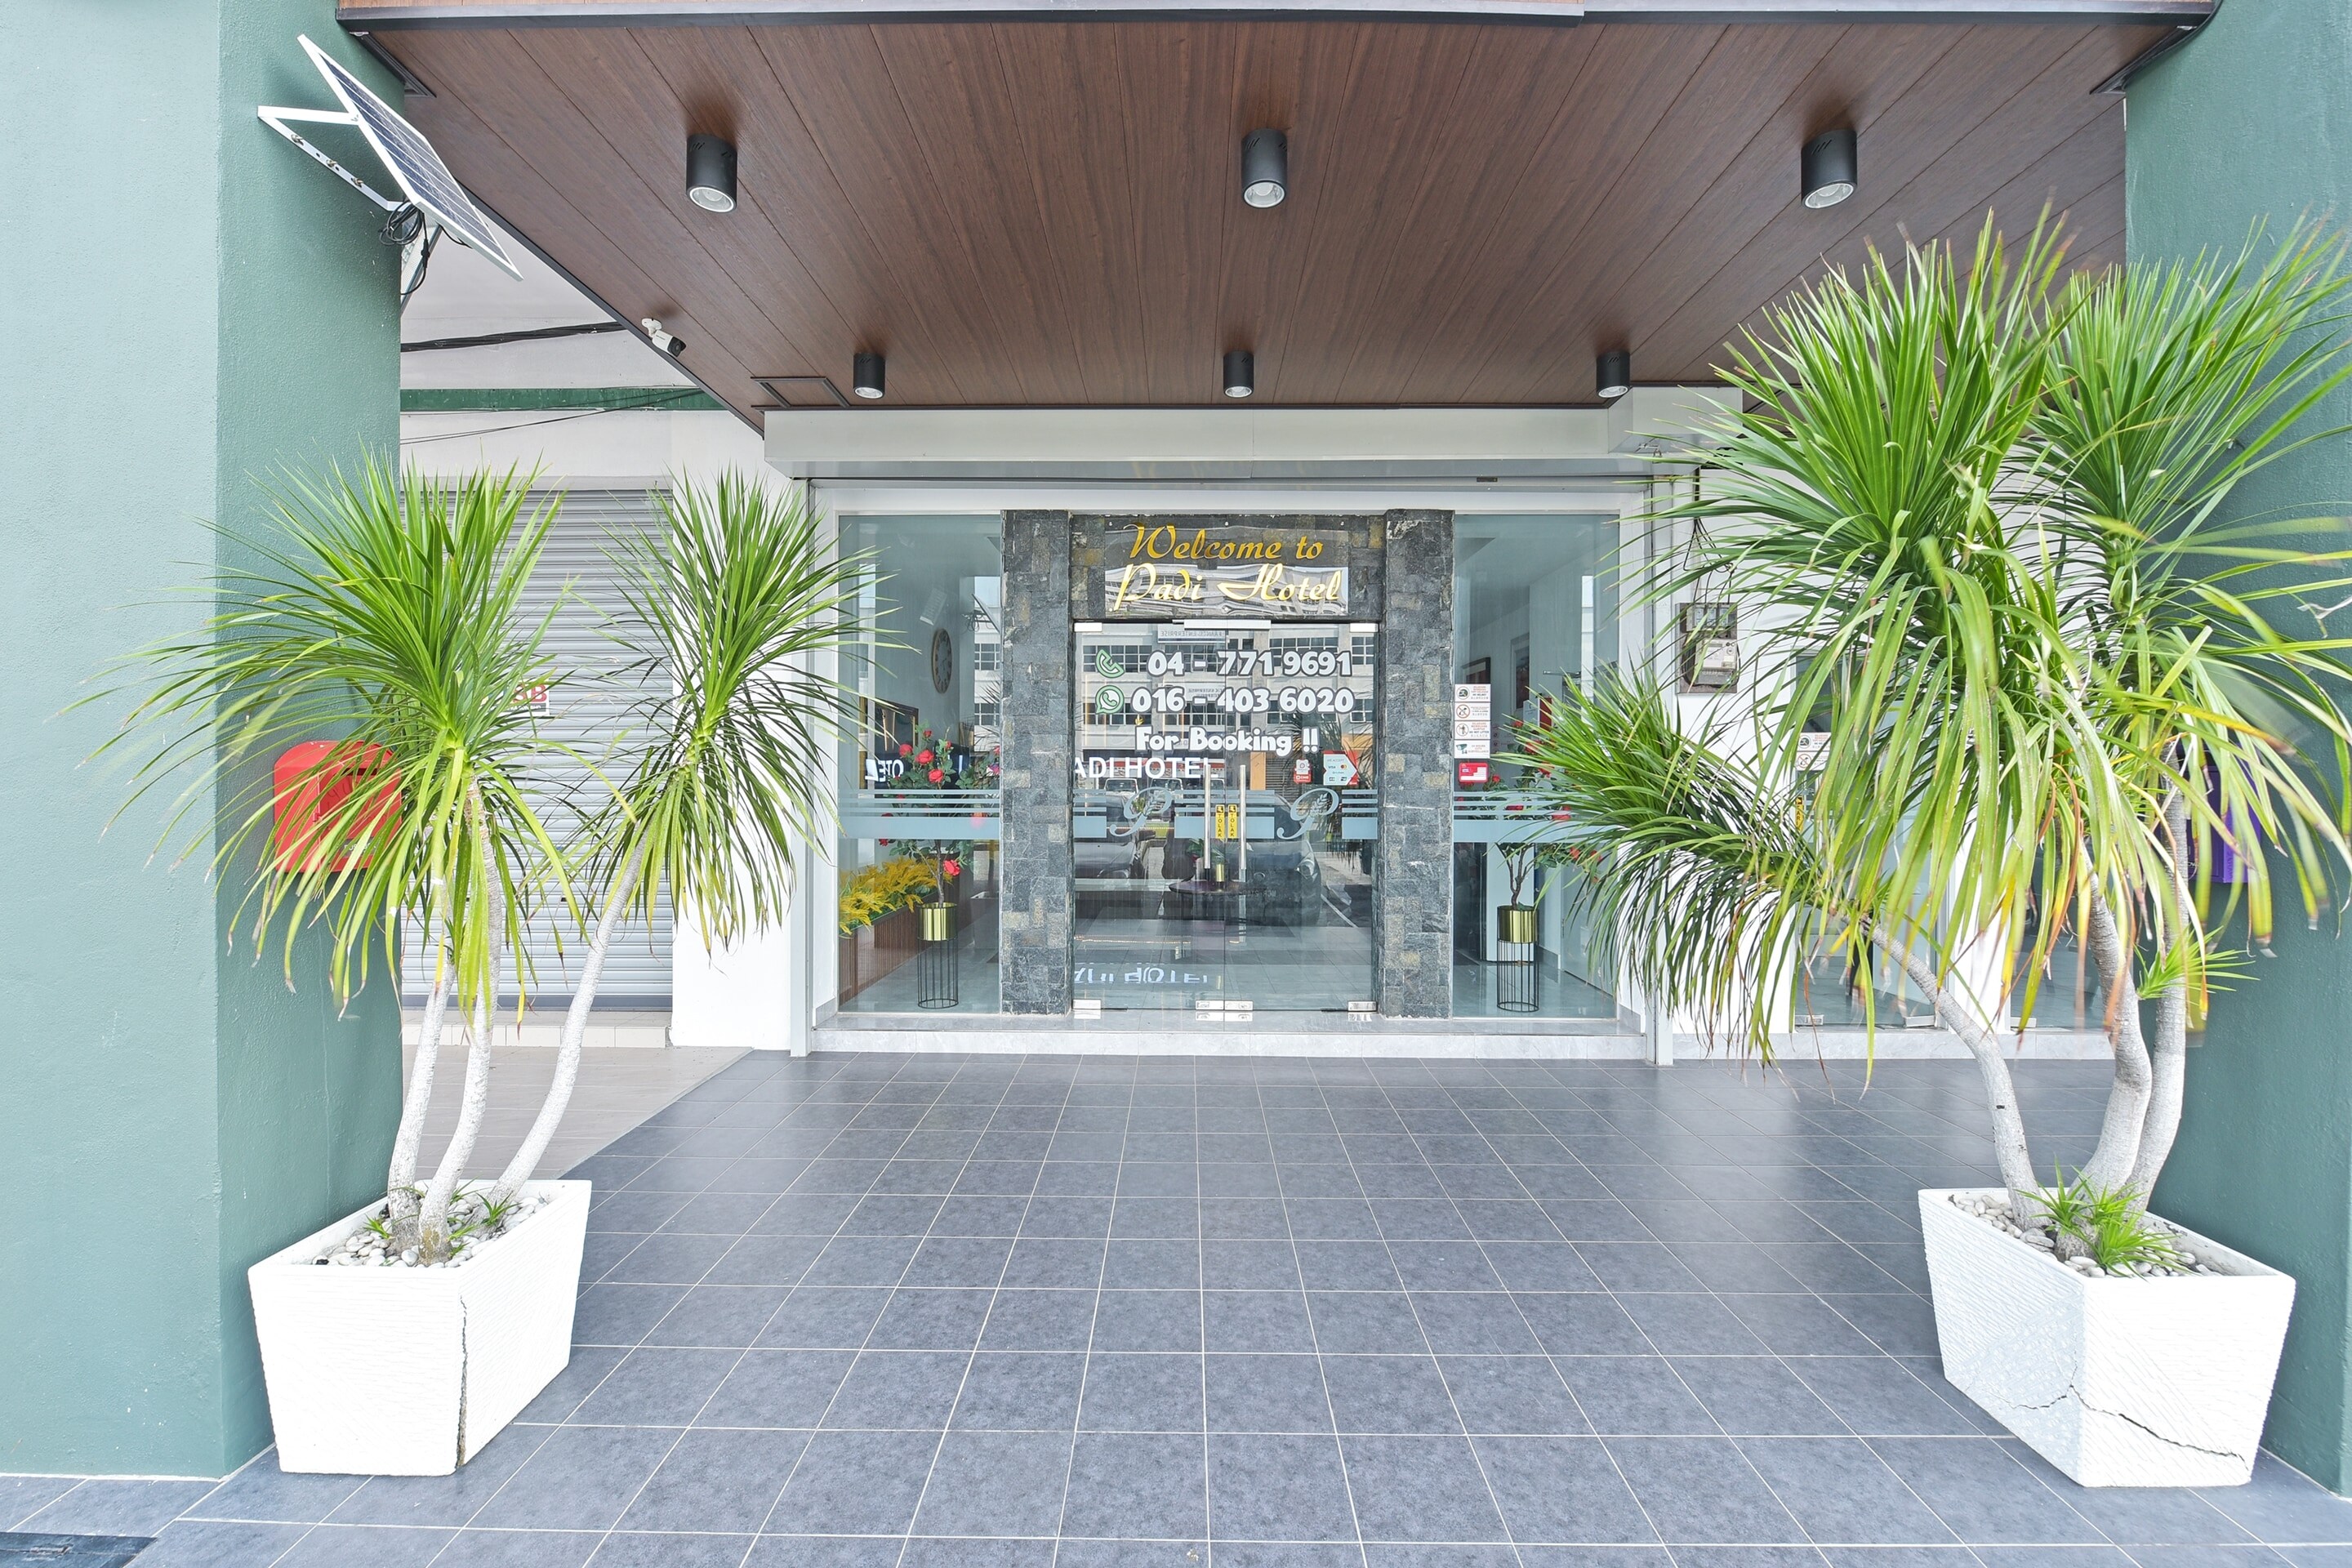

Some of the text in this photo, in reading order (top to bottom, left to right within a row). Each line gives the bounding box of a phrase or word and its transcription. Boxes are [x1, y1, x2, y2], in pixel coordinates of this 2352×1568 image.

[1123, 523, 1324, 559] Welcome to
[1113, 563, 1343, 612] Padi Hotel
[1147, 650, 1185, 676] 04
[1217, 650, 1275, 676] 771
[1282, 650, 1353, 676] 9691
[1131, 686, 1186, 713] 016
[1216, 686, 1271, 713] 403
[1278, 686, 1356, 714] 6020
[1134, 724, 1181, 752] For
[1187, 724, 1294, 758] Booking
[1124, 756, 1219, 779] HOTEL
